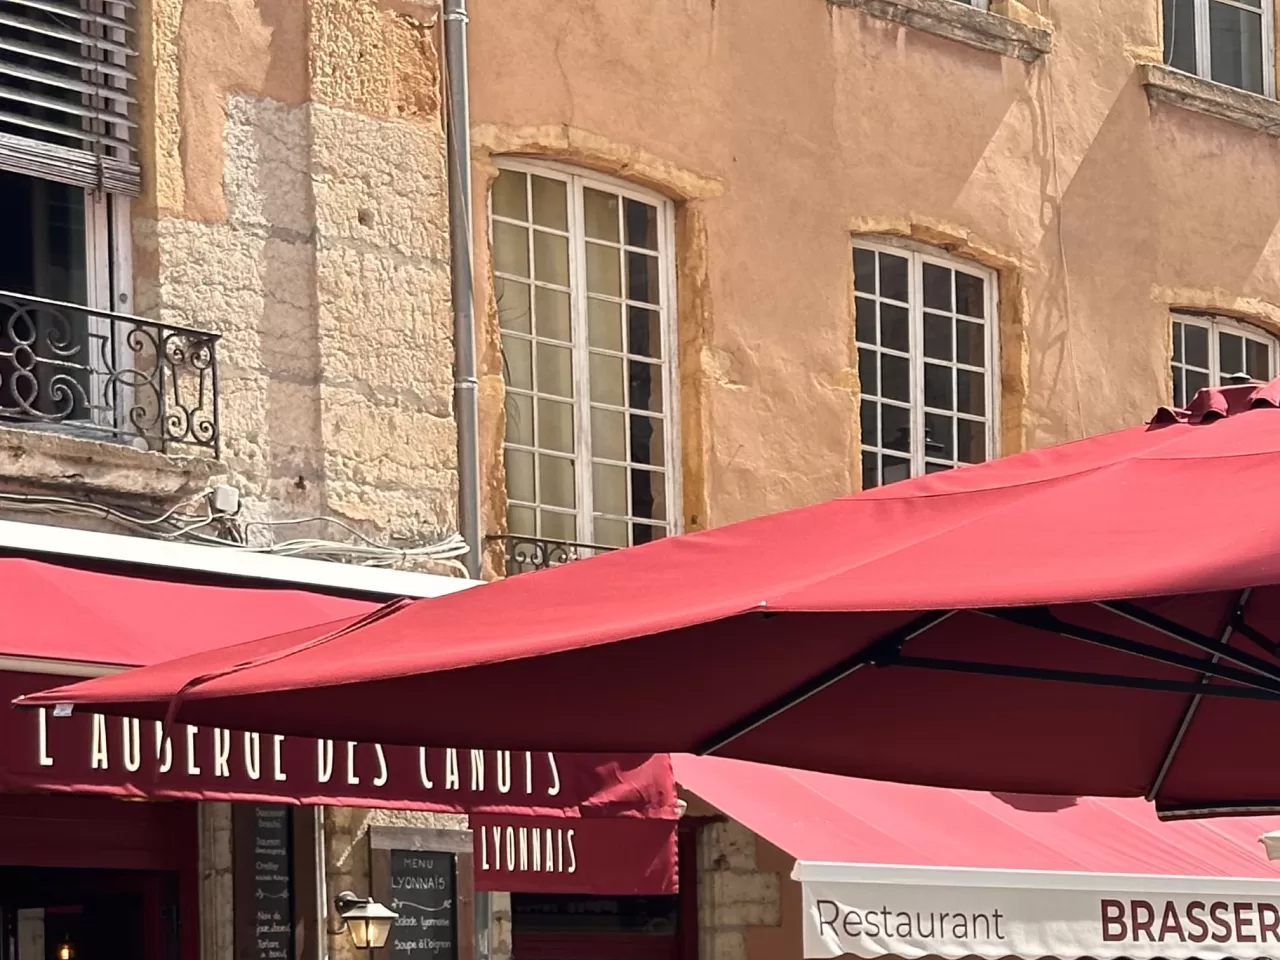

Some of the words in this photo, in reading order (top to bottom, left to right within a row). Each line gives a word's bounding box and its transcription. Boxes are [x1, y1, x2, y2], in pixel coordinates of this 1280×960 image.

[403, 858, 434, 869] MENU
[481, 825, 577, 873] LYONNAIS
[816, 899, 1005, 941] Restaurant
